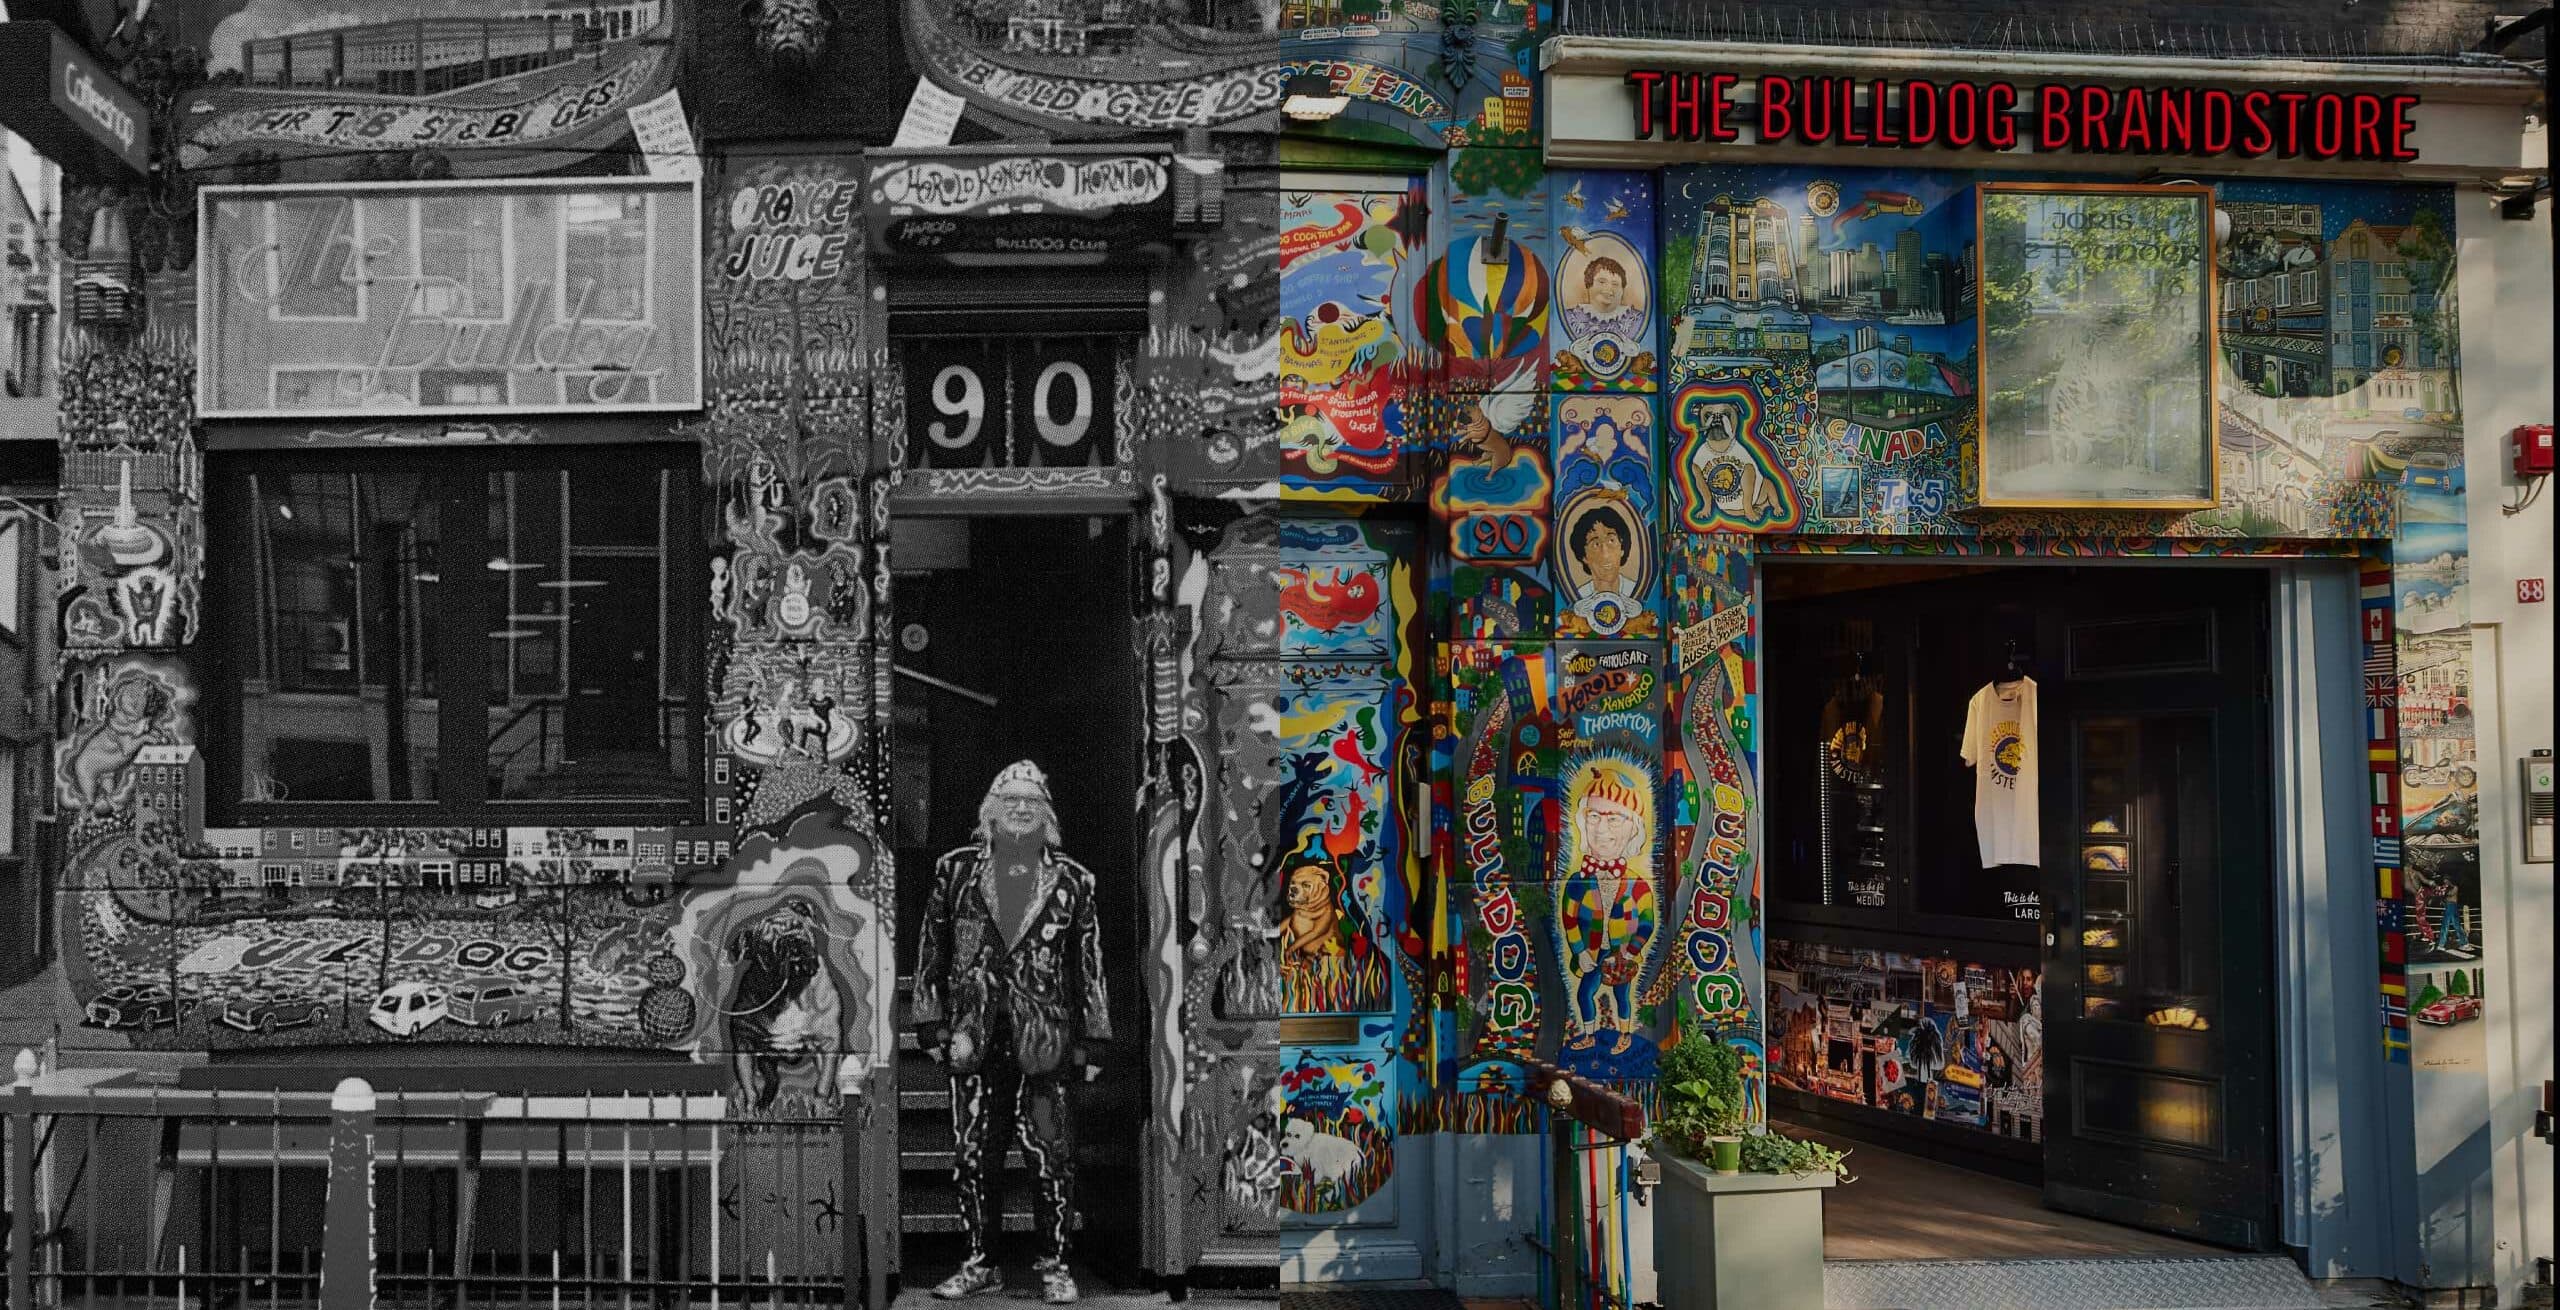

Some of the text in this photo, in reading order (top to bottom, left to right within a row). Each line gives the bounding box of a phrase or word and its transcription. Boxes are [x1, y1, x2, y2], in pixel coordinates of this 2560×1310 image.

[1630, 70, 2420, 158] THE BULLDOG BRANDSTORE
[1293, 230, 1336, 243] COCKTAIL
[2052, 211, 2133, 230] JORIS
[726, 233, 849, 281] JUICE
[1827, 418, 1947, 465] CANADA
[1474, 515, 1529, 553] 90
[1566, 650, 1649, 675] WORLD FAMOUS ART
[1601, 673, 1653, 714] KANGAROO
[1582, 712, 1657, 740] THORNTON
[1467, 774, 1535, 1030] BULLDOG
[1686, 783, 1743, 1014] BULLDOG
[2003, 891, 2018, 904] This
[2027, 891, 2040, 904] the
